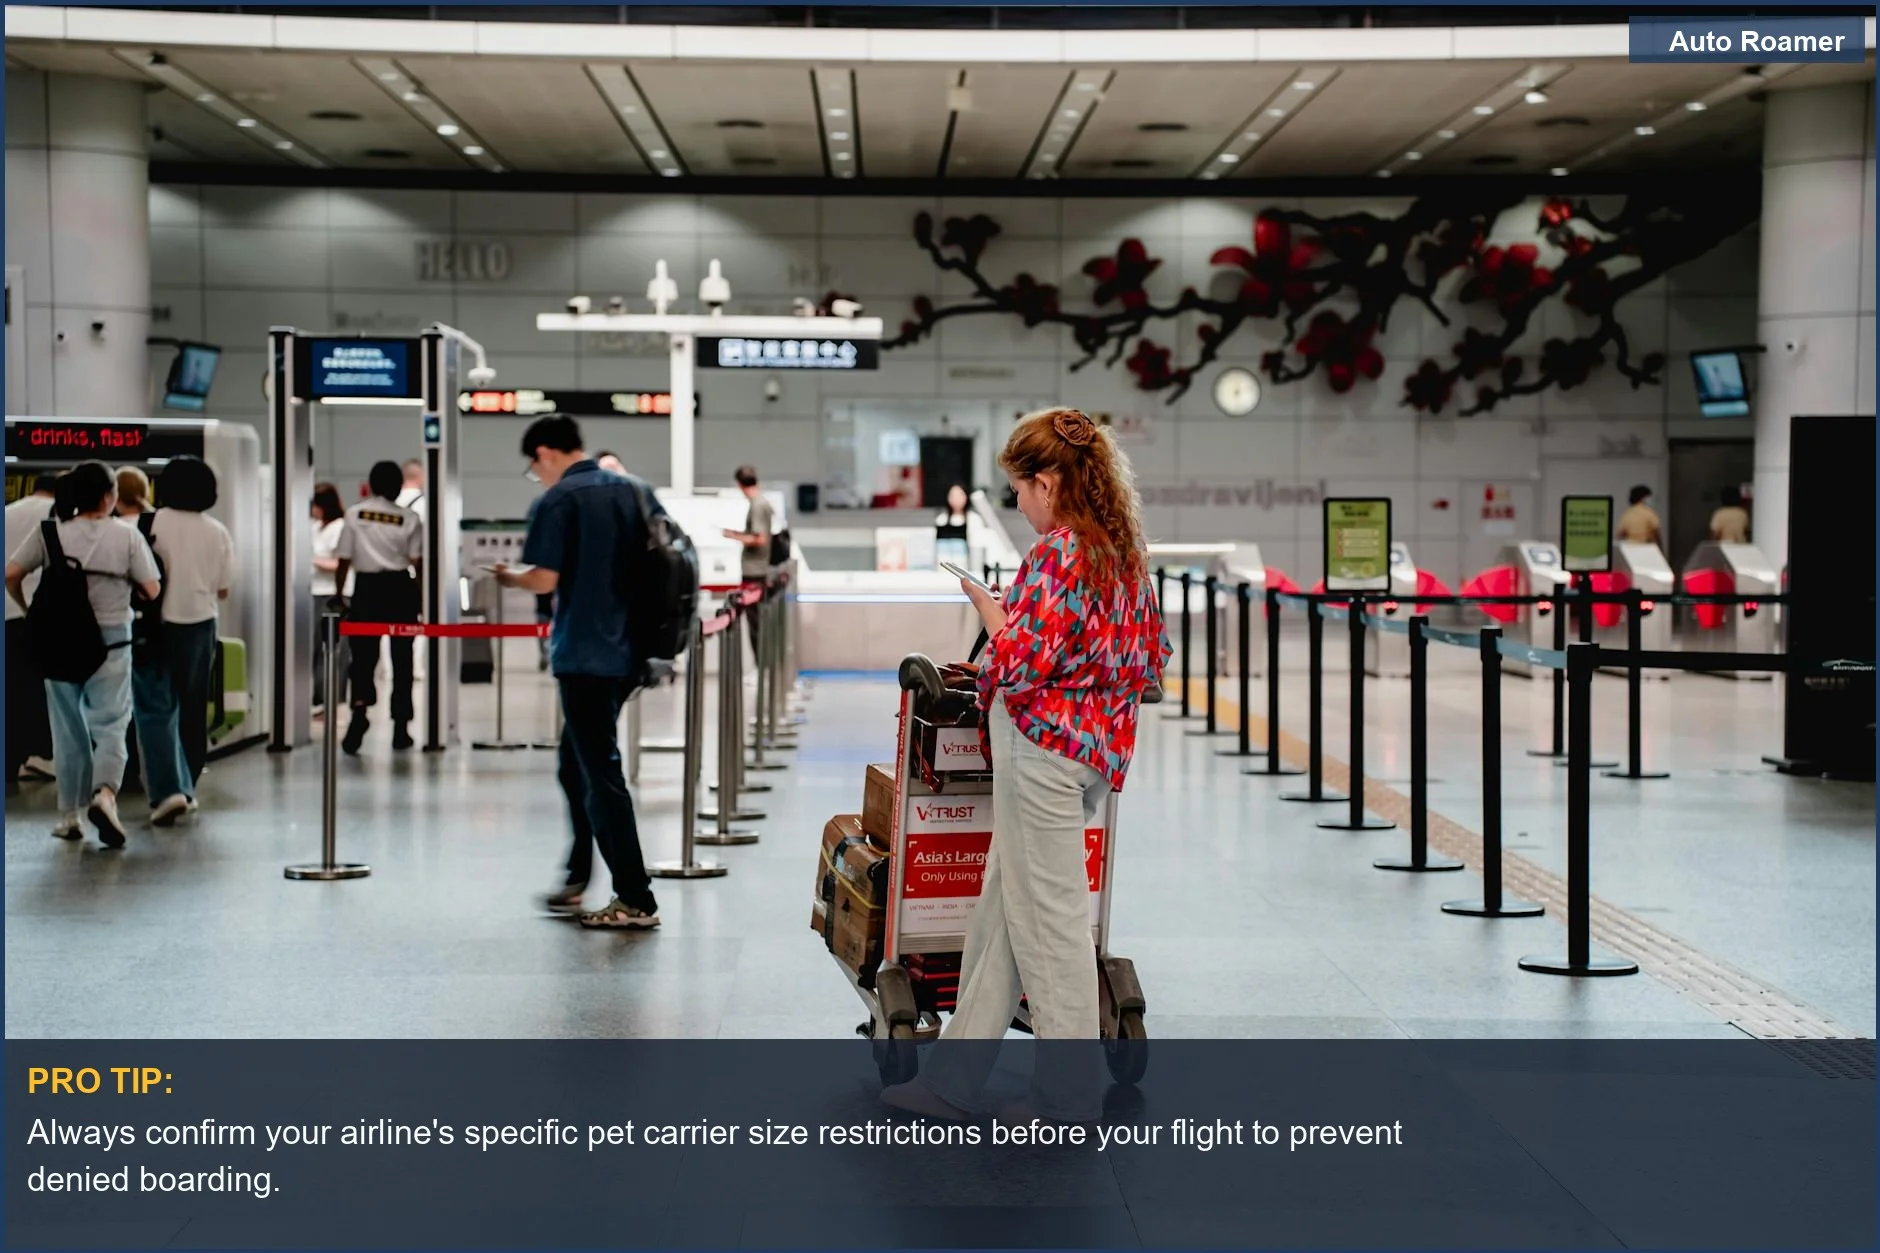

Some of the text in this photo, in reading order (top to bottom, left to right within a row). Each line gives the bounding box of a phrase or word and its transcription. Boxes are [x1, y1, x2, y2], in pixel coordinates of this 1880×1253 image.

[414, 241, 511, 280] HELLO
[31, 427, 95, 448] drinks,
[914, 851, 952, 864] Asia's
[921, 872, 946, 883] Only
[949, 872, 978, 882] Using
